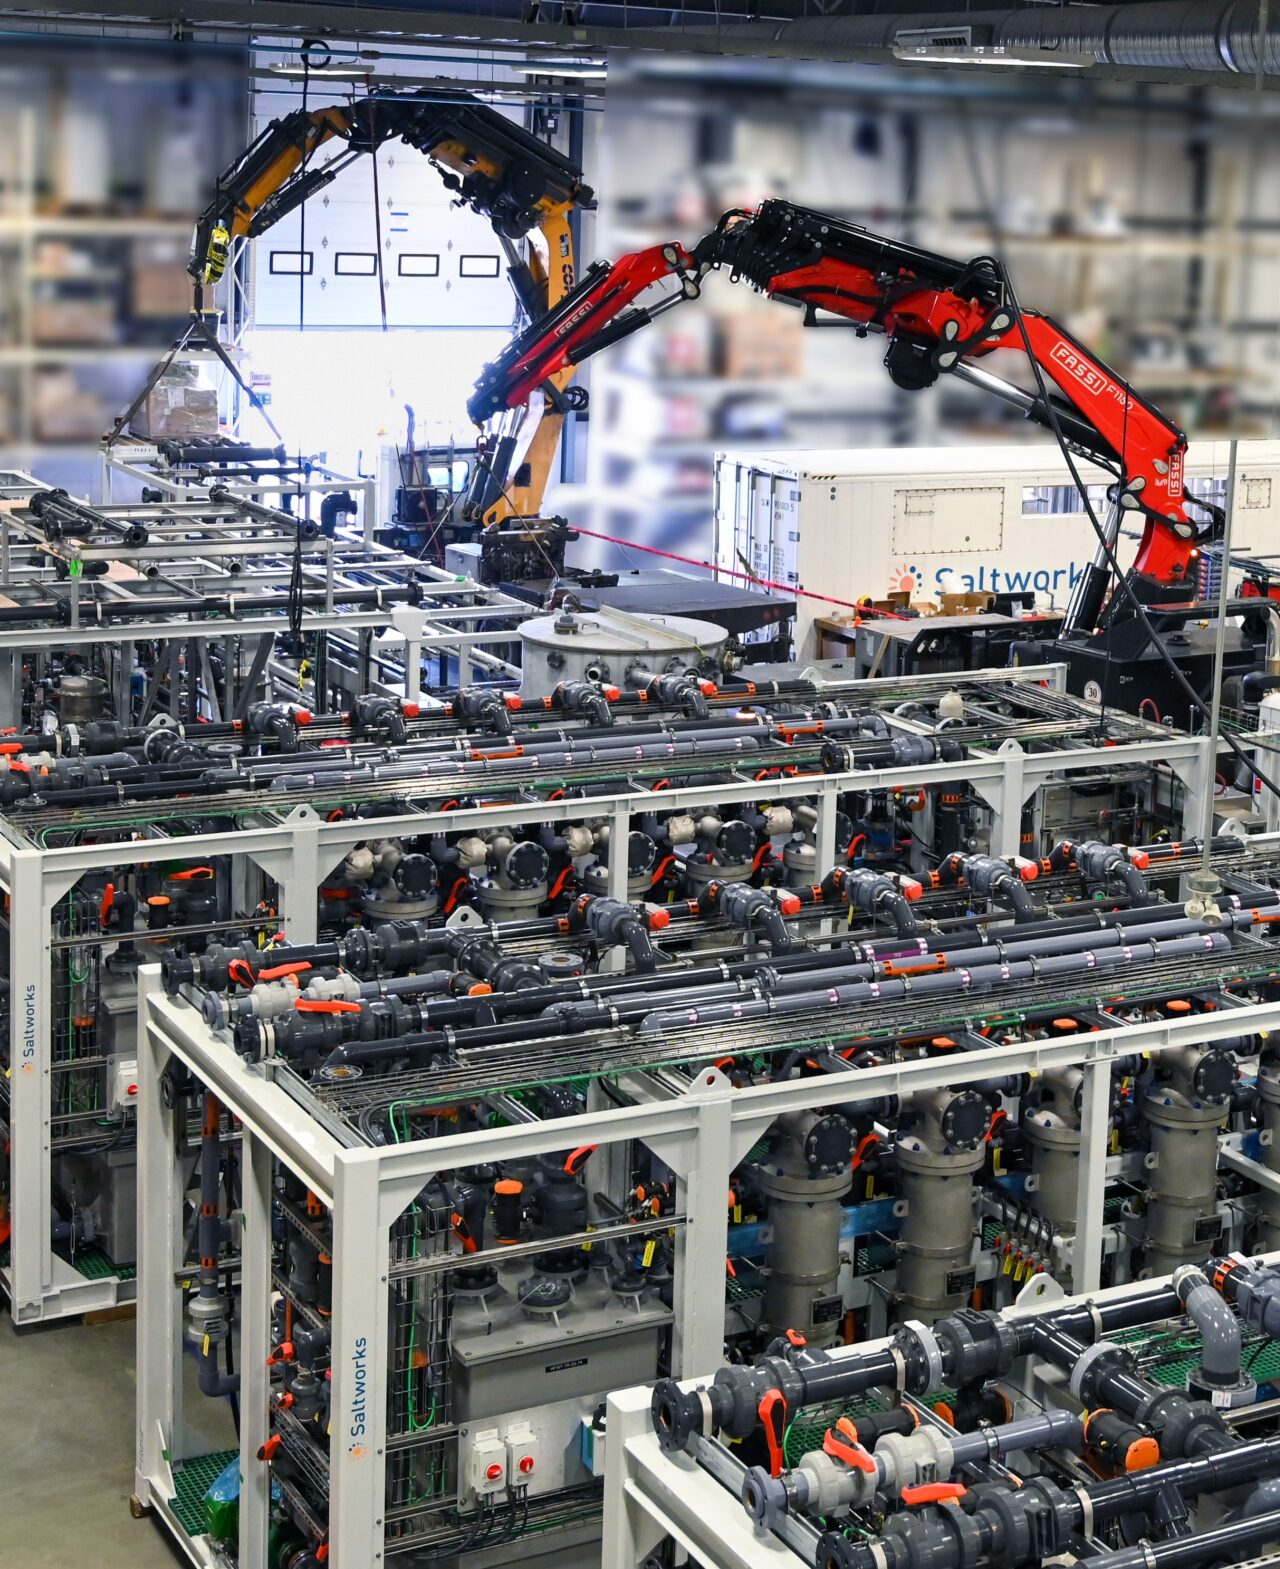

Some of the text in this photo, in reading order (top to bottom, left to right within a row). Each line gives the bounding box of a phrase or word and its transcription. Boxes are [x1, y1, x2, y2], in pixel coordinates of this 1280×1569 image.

[1056, 347, 1102, 390] FASSI
[1171, 453, 1180, 494] FASSI
[934, 562, 1085, 597] Saltwork
[1088, 687, 1098, 699] 30
[23, 984, 36, 1058] Saltworks
[351, 1337, 367, 1437] Saltworks
